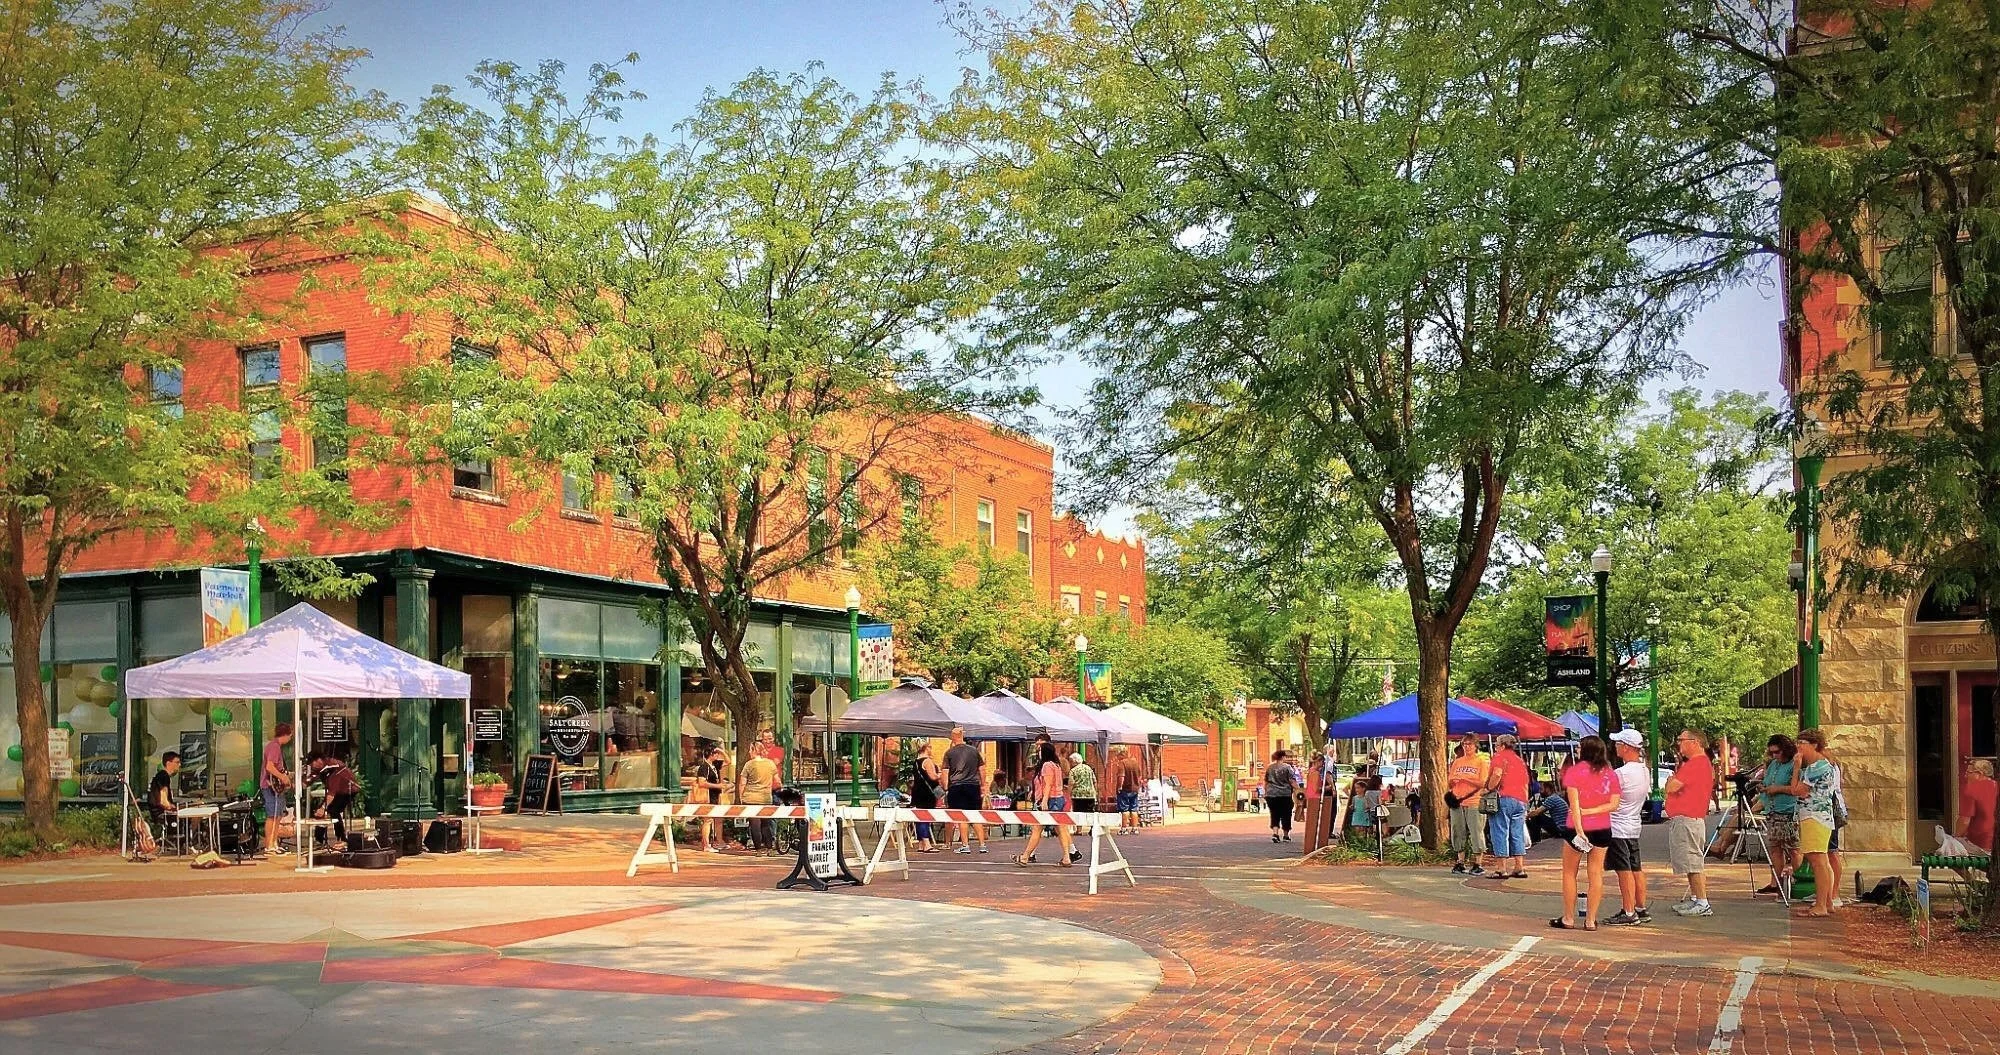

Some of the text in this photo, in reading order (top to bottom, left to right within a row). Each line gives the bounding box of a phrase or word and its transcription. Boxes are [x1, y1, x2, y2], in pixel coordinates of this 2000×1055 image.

[1553, 604, 1571, 612] SHOP
[1920, 643, 1979, 655] CITIZENS
[1557, 668, 1591, 676] ASHLAND
[549, 719, 591, 727] SALT CREEK
[823, 808, 835, 818] 9-12
[824, 830, 836, 840] SAT.
[811, 841, 835, 852] FARMERS
